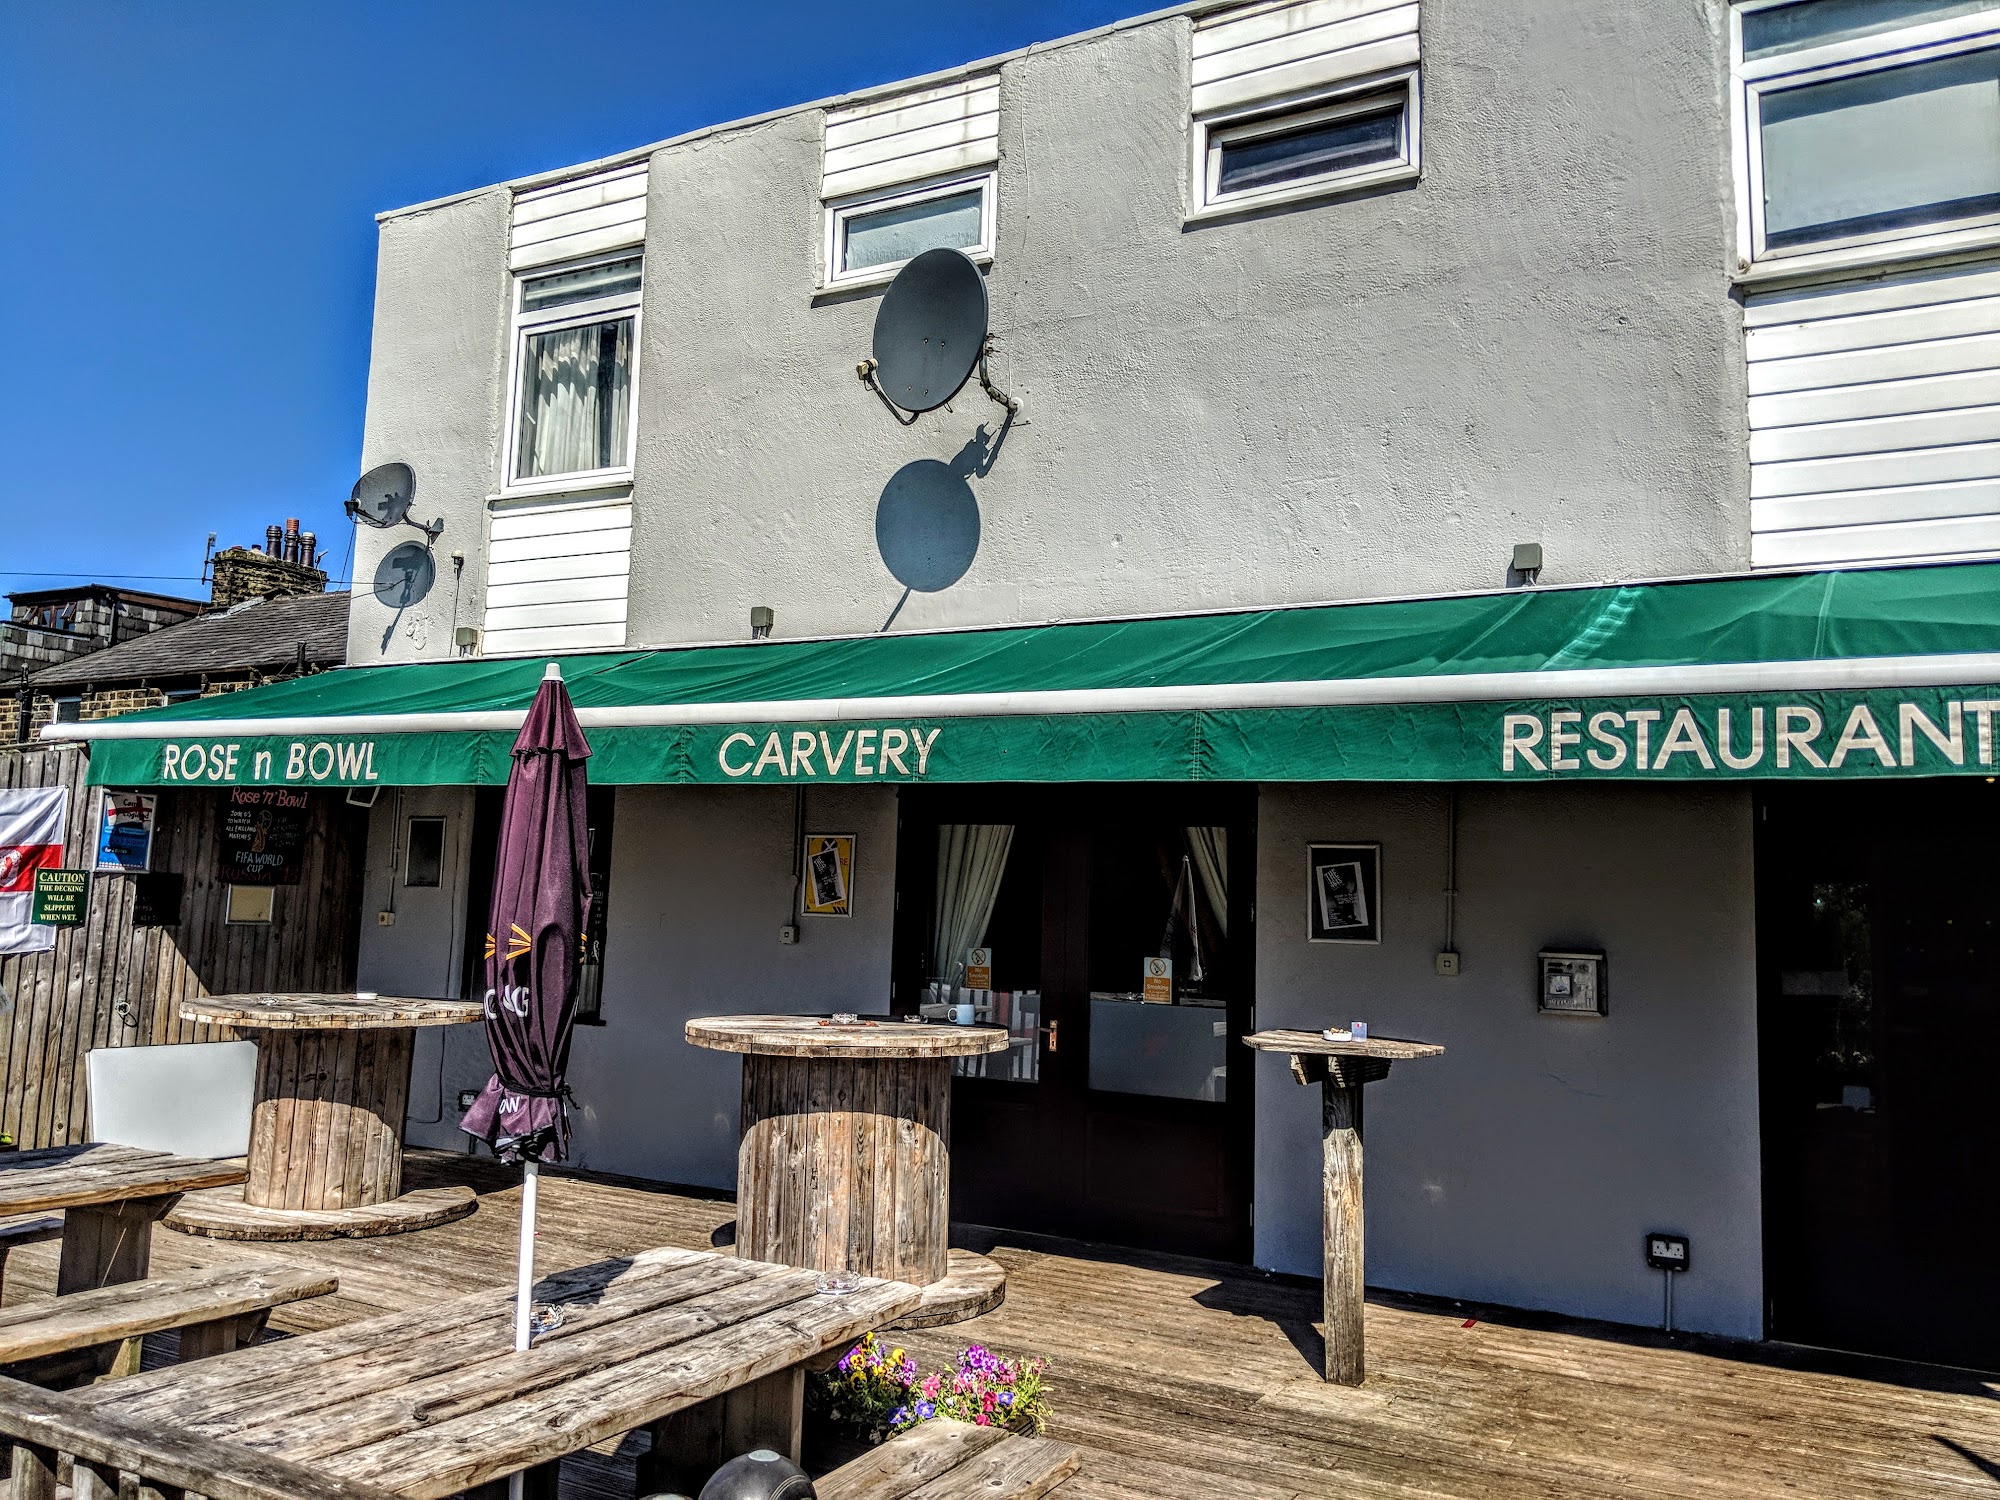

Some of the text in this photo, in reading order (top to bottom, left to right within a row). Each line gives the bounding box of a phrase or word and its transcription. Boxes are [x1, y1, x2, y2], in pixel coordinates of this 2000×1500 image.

[1502, 701, 2000, 771] RESTAURANT
[718, 728, 942, 777] CARVERY
[163, 742, 379, 781] ROSE n BOWL
[230, 786, 261, 805] Rose
[276, 789, 309, 809] Bowl
[235, 850, 284, 867] FIFA WORLD
[246, 864, 264, 873] CUP
[39, 871, 86, 882] CAUTION
[54, 885, 85, 893] DECKING
[47, 894, 75, 902] WILL BE
[39, 913, 61, 921] WHEN
[1146, 983, 1169, 992] Smoking
